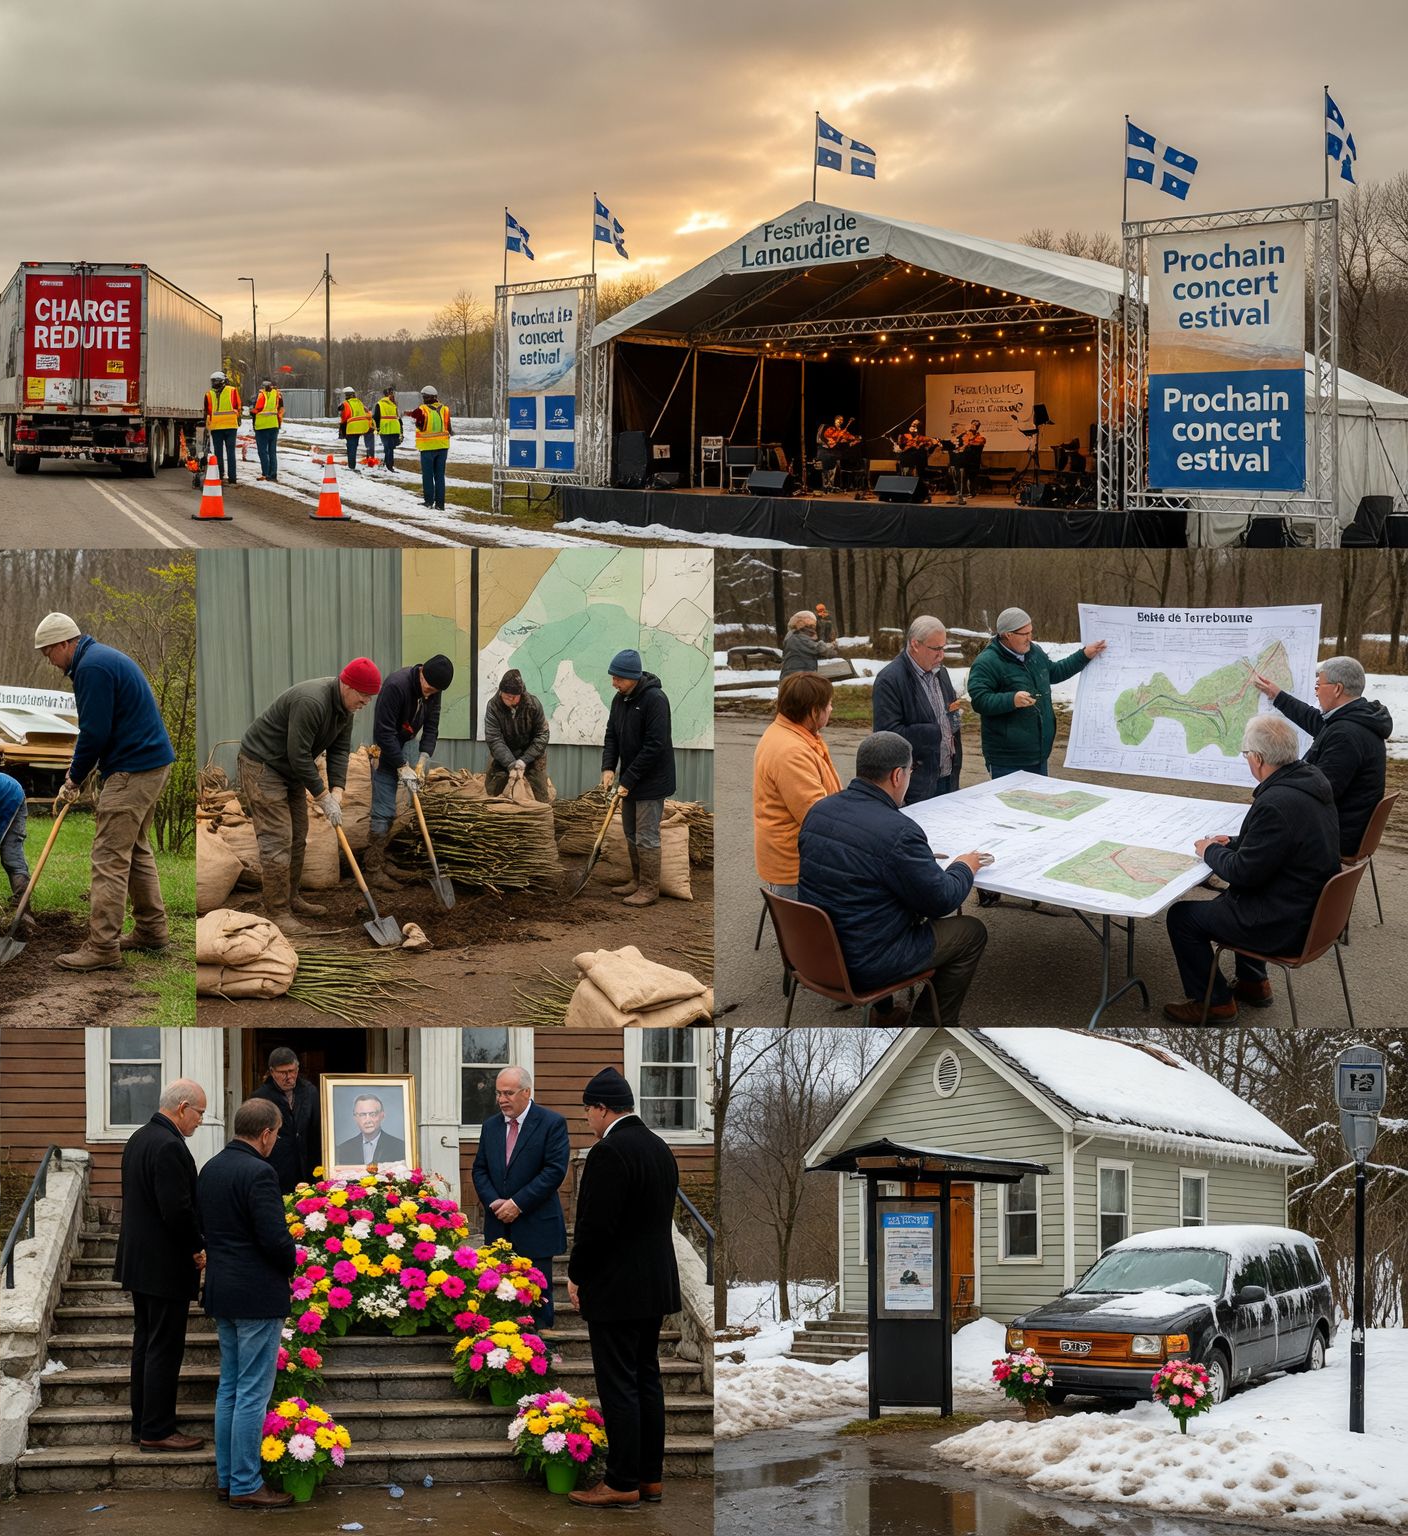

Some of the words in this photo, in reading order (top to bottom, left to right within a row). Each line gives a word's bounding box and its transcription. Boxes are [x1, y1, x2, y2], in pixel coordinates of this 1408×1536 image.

[764, 214, 832, 242] Festival
[834, 213, 857, 231] de
[1163, 240, 1285, 273] Prochain
[1173, 271, 1279, 300] concert
[35, 298, 131, 322] CHARGE
[1179, 299, 1270, 329] estival
[519, 329, 565, 345] concert
[1163, 384, 1289, 412] Prochain
[1172, 418, 1281, 441] concert
[1177, 445, 1270, 472] estival
